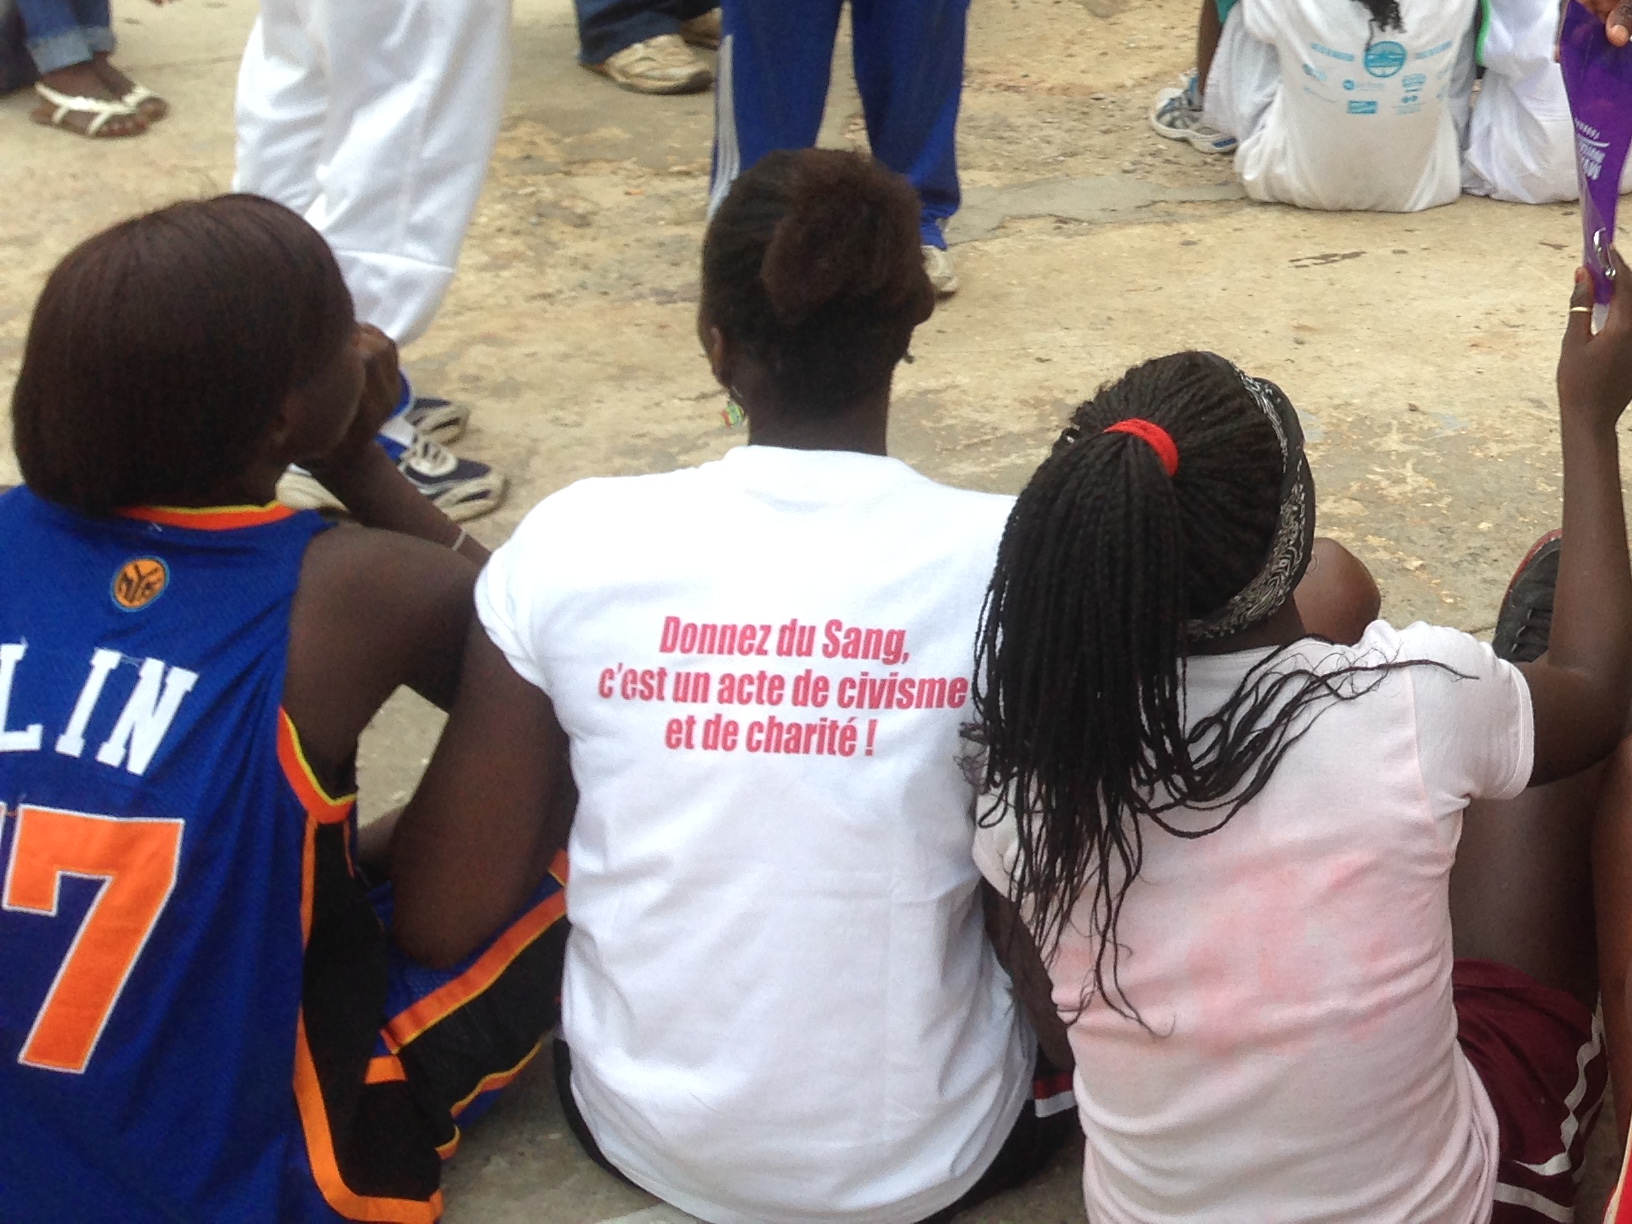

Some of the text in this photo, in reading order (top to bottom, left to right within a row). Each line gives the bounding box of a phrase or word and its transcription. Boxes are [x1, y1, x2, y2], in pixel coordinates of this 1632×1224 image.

[659, 615, 911, 665] Donnez du Sang,
[0, 641, 199, 776] LIN
[597, 662, 969, 710] c'est un acte de civisme
[665, 715, 697, 751] et
[702, 714, 740, 752] de
[745, 715, 859, 758] charité
